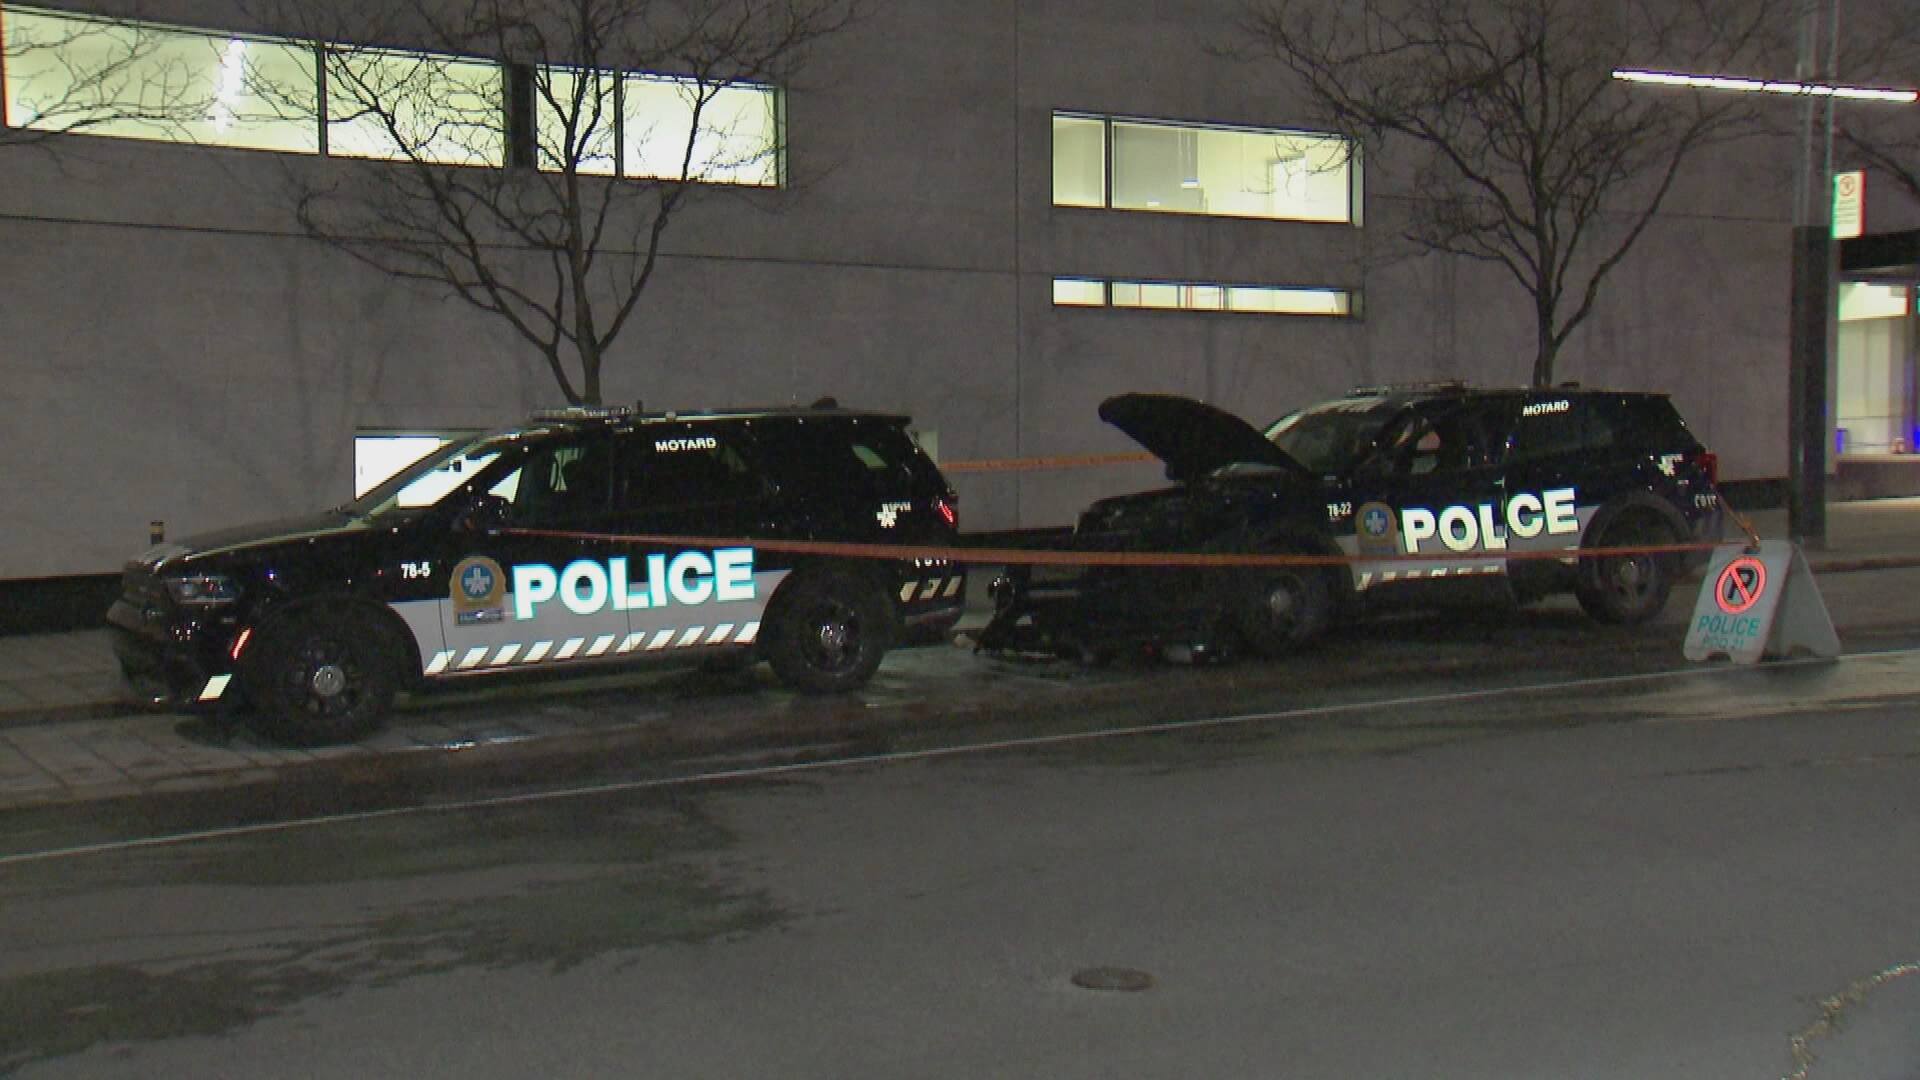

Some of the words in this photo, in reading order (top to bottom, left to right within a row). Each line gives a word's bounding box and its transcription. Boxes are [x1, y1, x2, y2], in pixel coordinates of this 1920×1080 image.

[1523, 400, 1569, 416] MOTARD
[655, 438, 717, 453] MOTARD
[1402, 487, 1580, 553] POLCE
[513, 547, 757, 620] POLICE
[1697, 615, 1760, 637] POLICE
